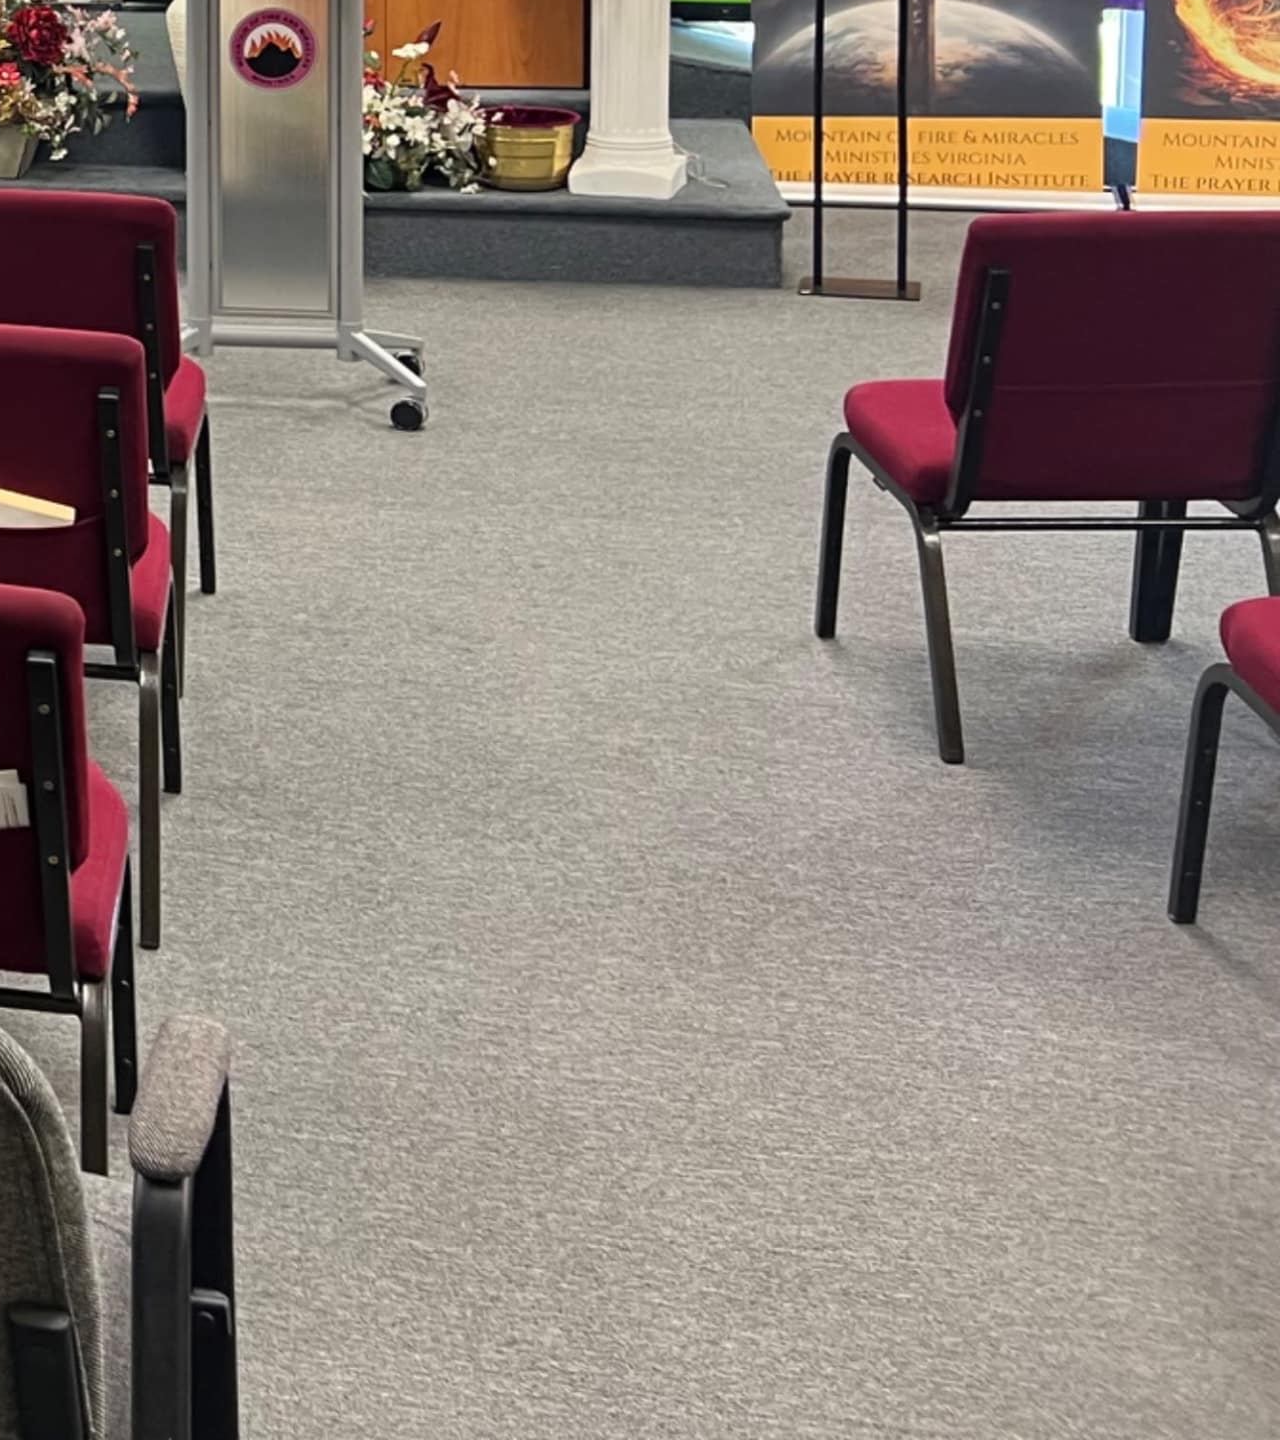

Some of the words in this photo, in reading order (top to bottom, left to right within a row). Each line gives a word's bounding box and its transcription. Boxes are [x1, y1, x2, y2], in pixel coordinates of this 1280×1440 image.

[917, 130, 957, 144] FIRE
[963, 129, 977, 144] &
[981, 130, 1080, 145] MIRACLES
[1162, 131, 1278, 149] MOUNTAIN
[935, 151, 1027, 166] VIRGINIA
[988, 170, 1089, 188] INSTITUTE
[1148, 173, 1188, 190] THE
[1196, 176, 1271, 192] PRAYER
